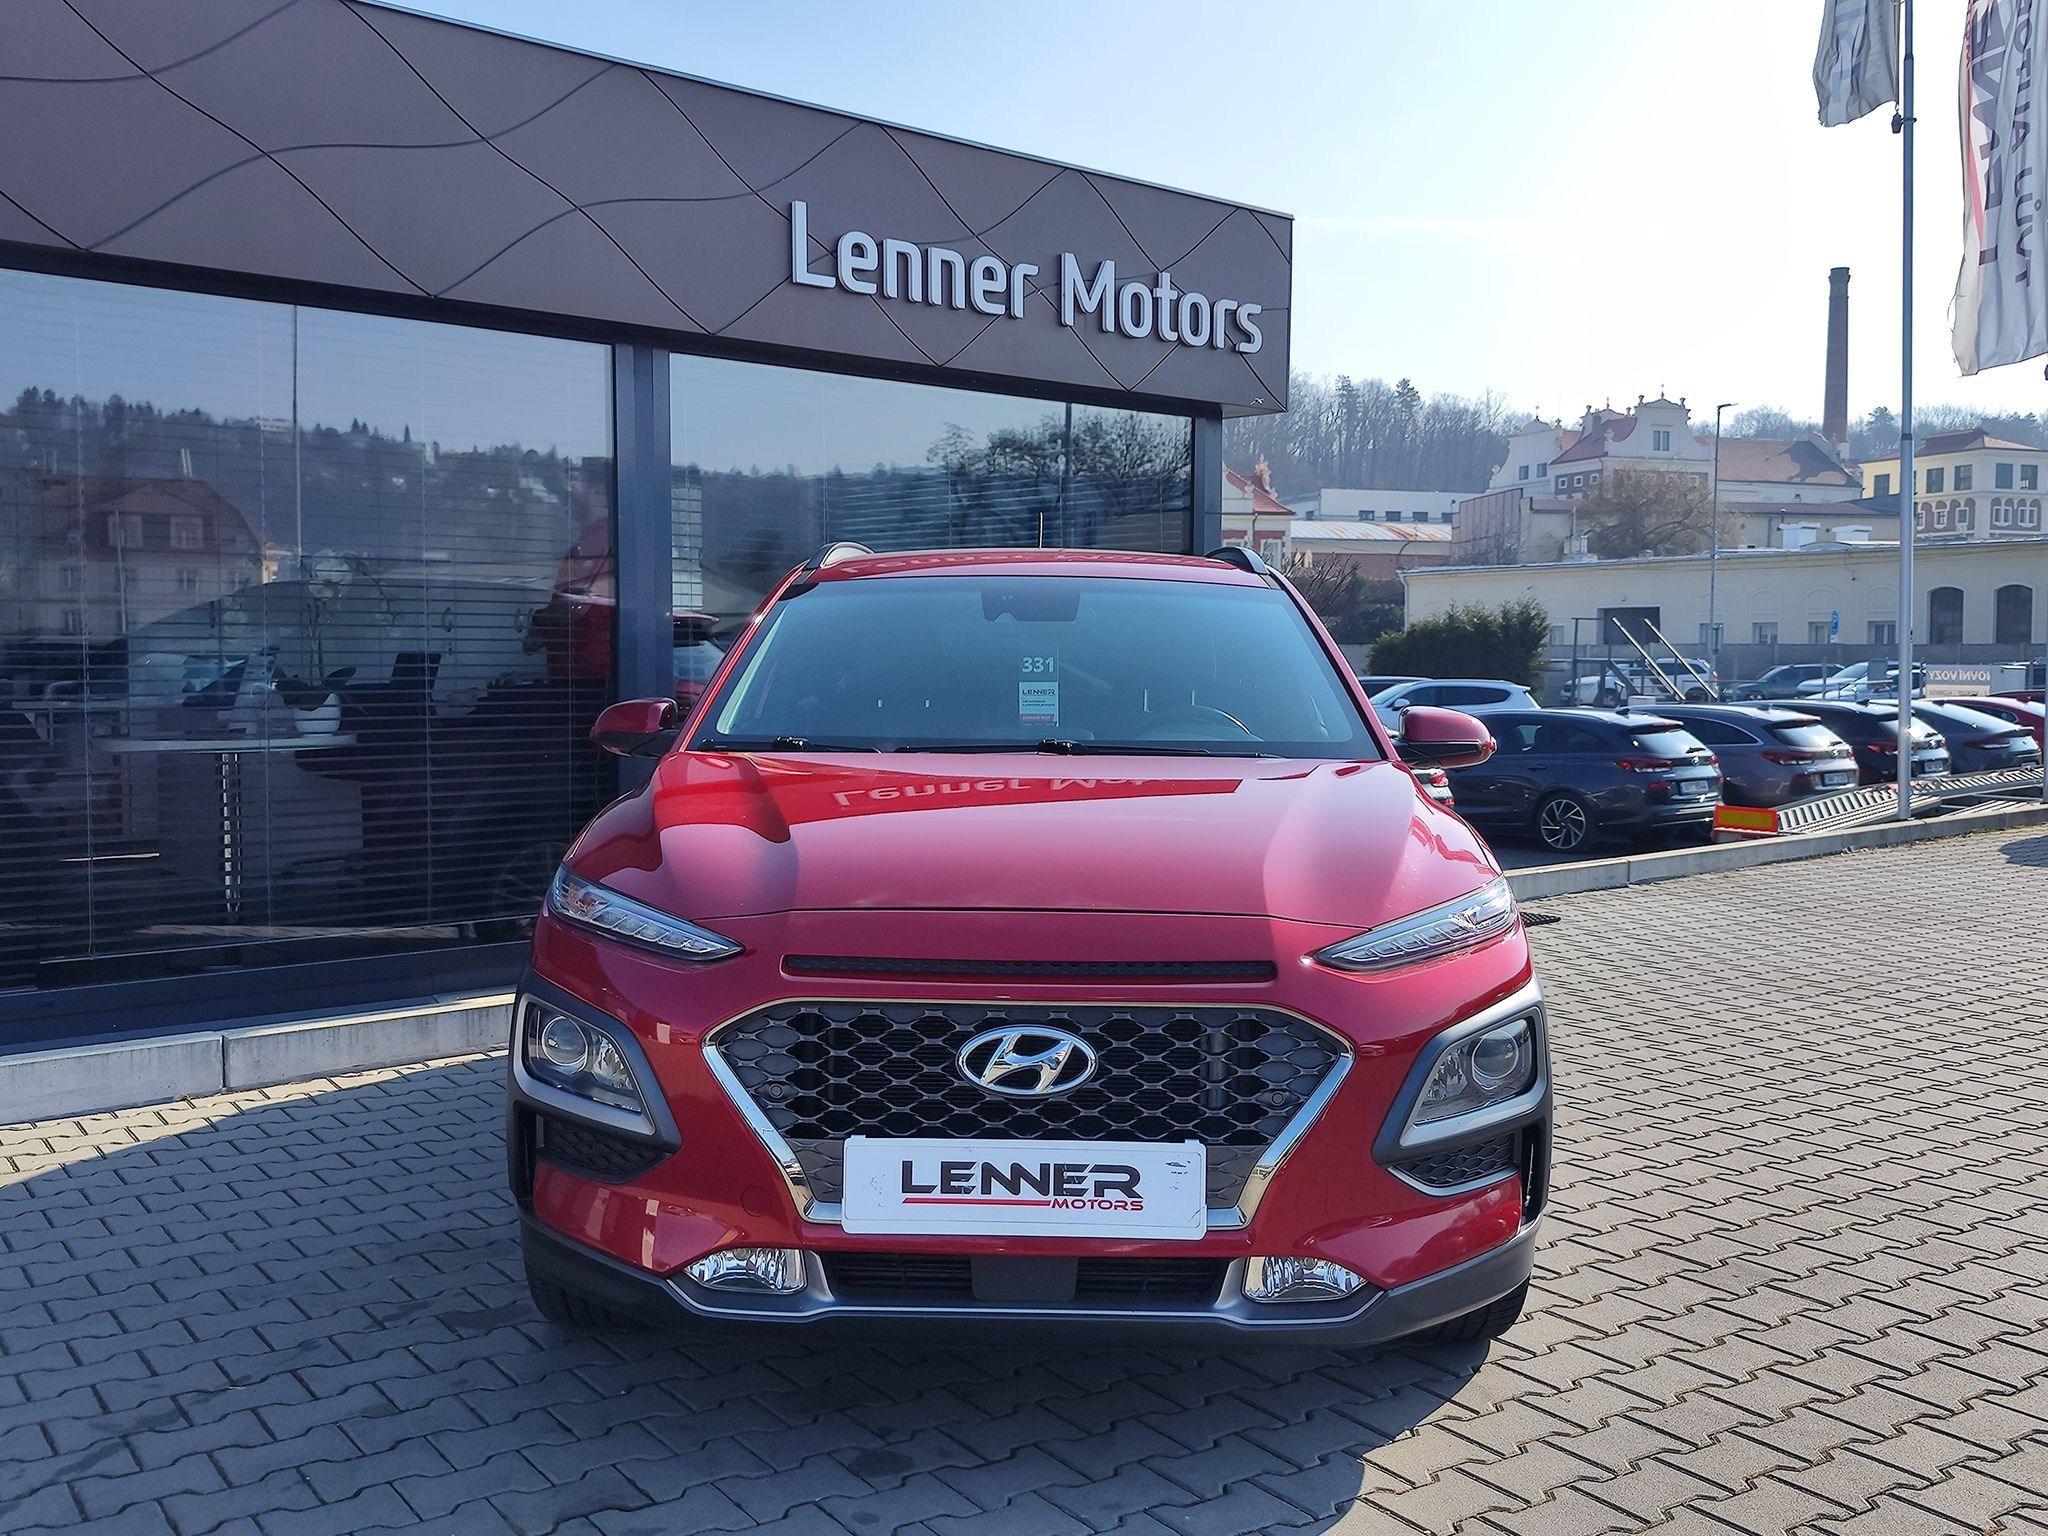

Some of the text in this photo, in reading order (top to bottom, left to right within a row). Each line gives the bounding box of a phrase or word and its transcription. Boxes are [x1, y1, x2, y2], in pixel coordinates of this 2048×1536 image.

[791, 200, 1264, 354] Lenner Motors
[1022, 656, 1054, 673] 331
[1022, 688, 1056, 696] LENNER
[901, 1160, 1144, 1199] LENNER
[1051, 1198, 1144, 1212] MOTORS
